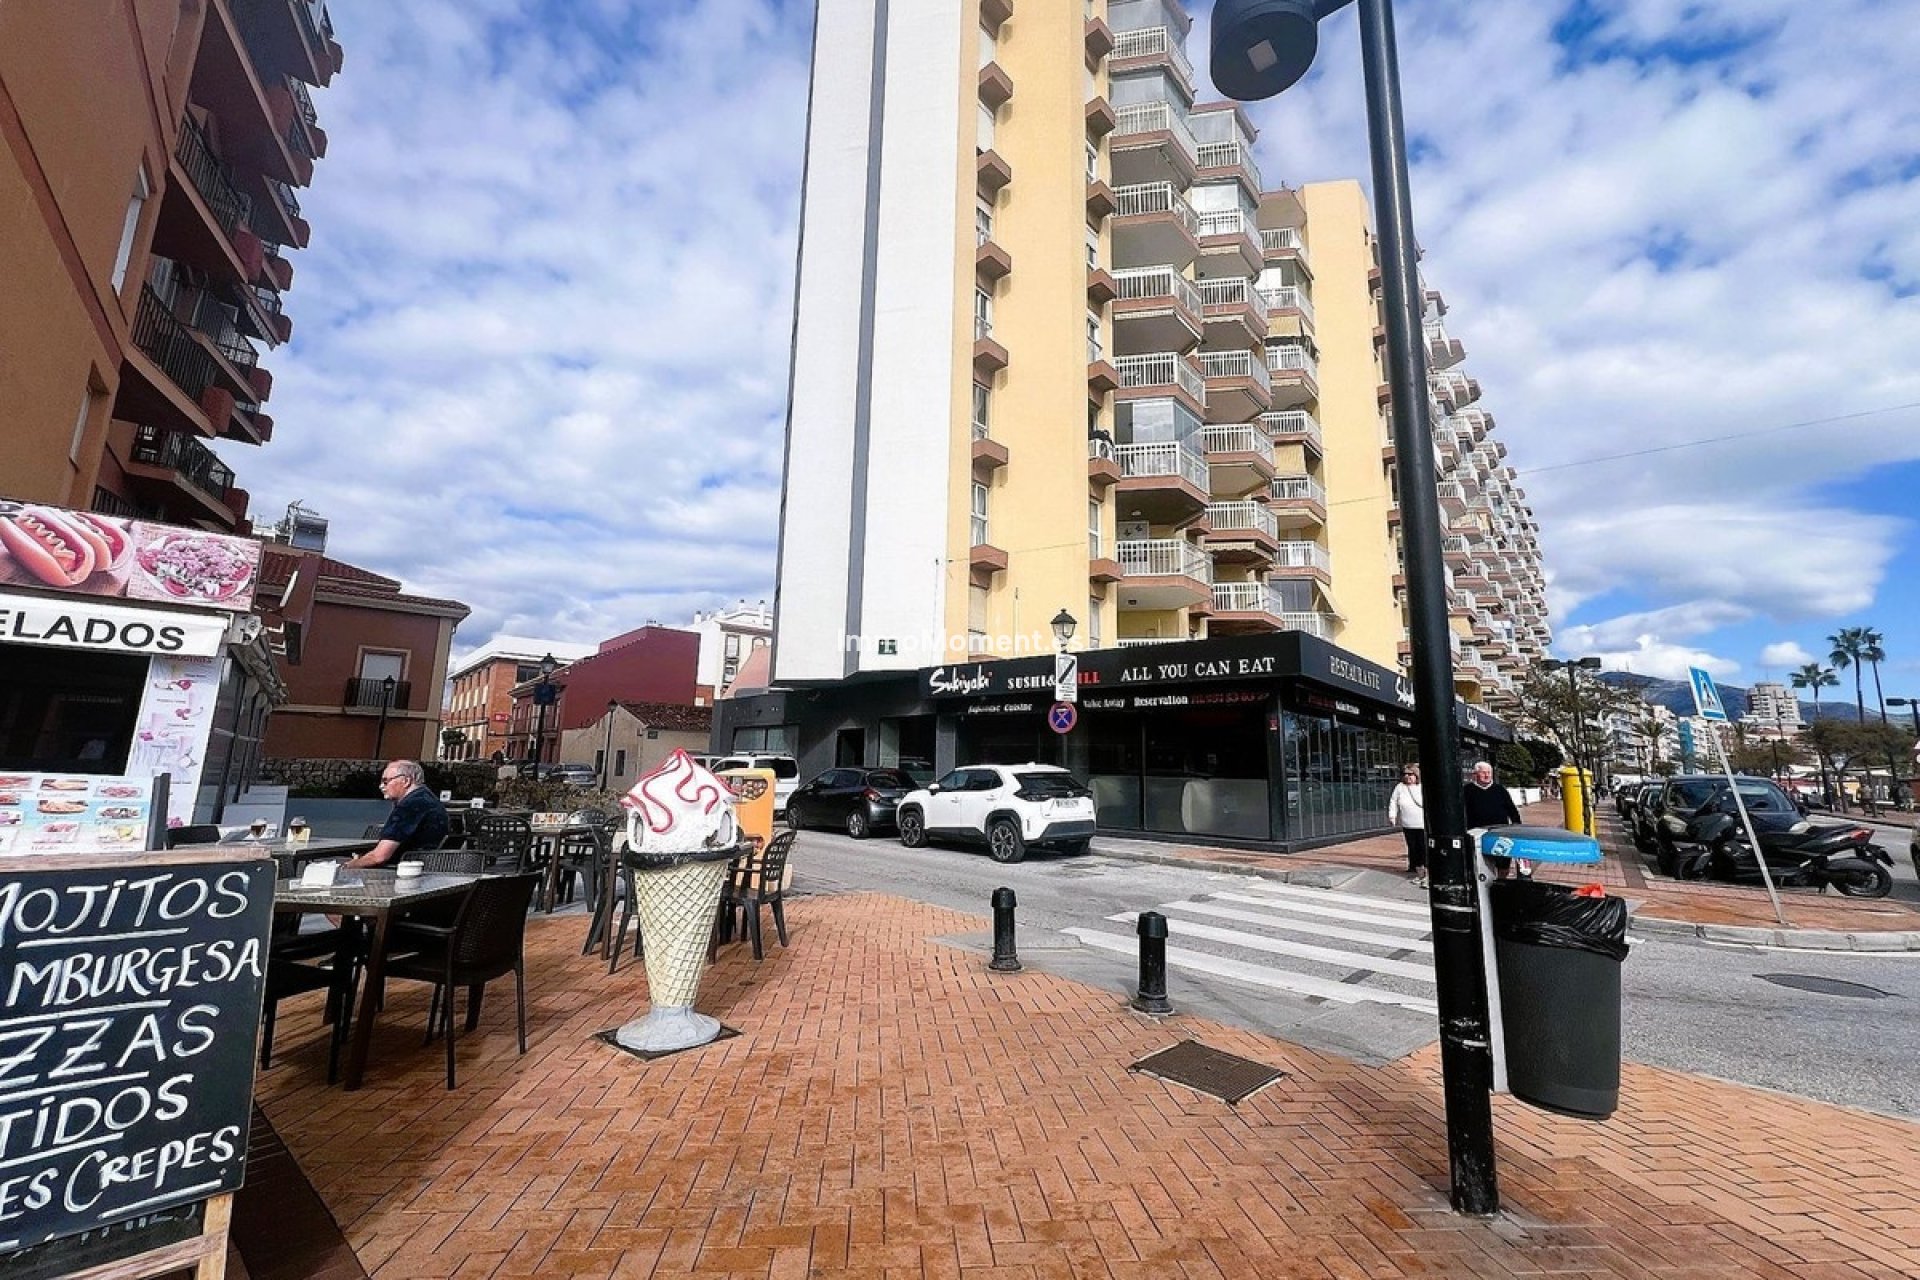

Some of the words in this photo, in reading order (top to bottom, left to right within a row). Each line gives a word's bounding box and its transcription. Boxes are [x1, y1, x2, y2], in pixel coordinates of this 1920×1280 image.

[1121, 667, 1152, 682] ALL
[1158, 664, 1188, 679] YOU
[1195, 661, 1231, 676] CAN
[1239, 657, 1275, 674] EAT
[8, 938, 263, 1007] MBURGESA
